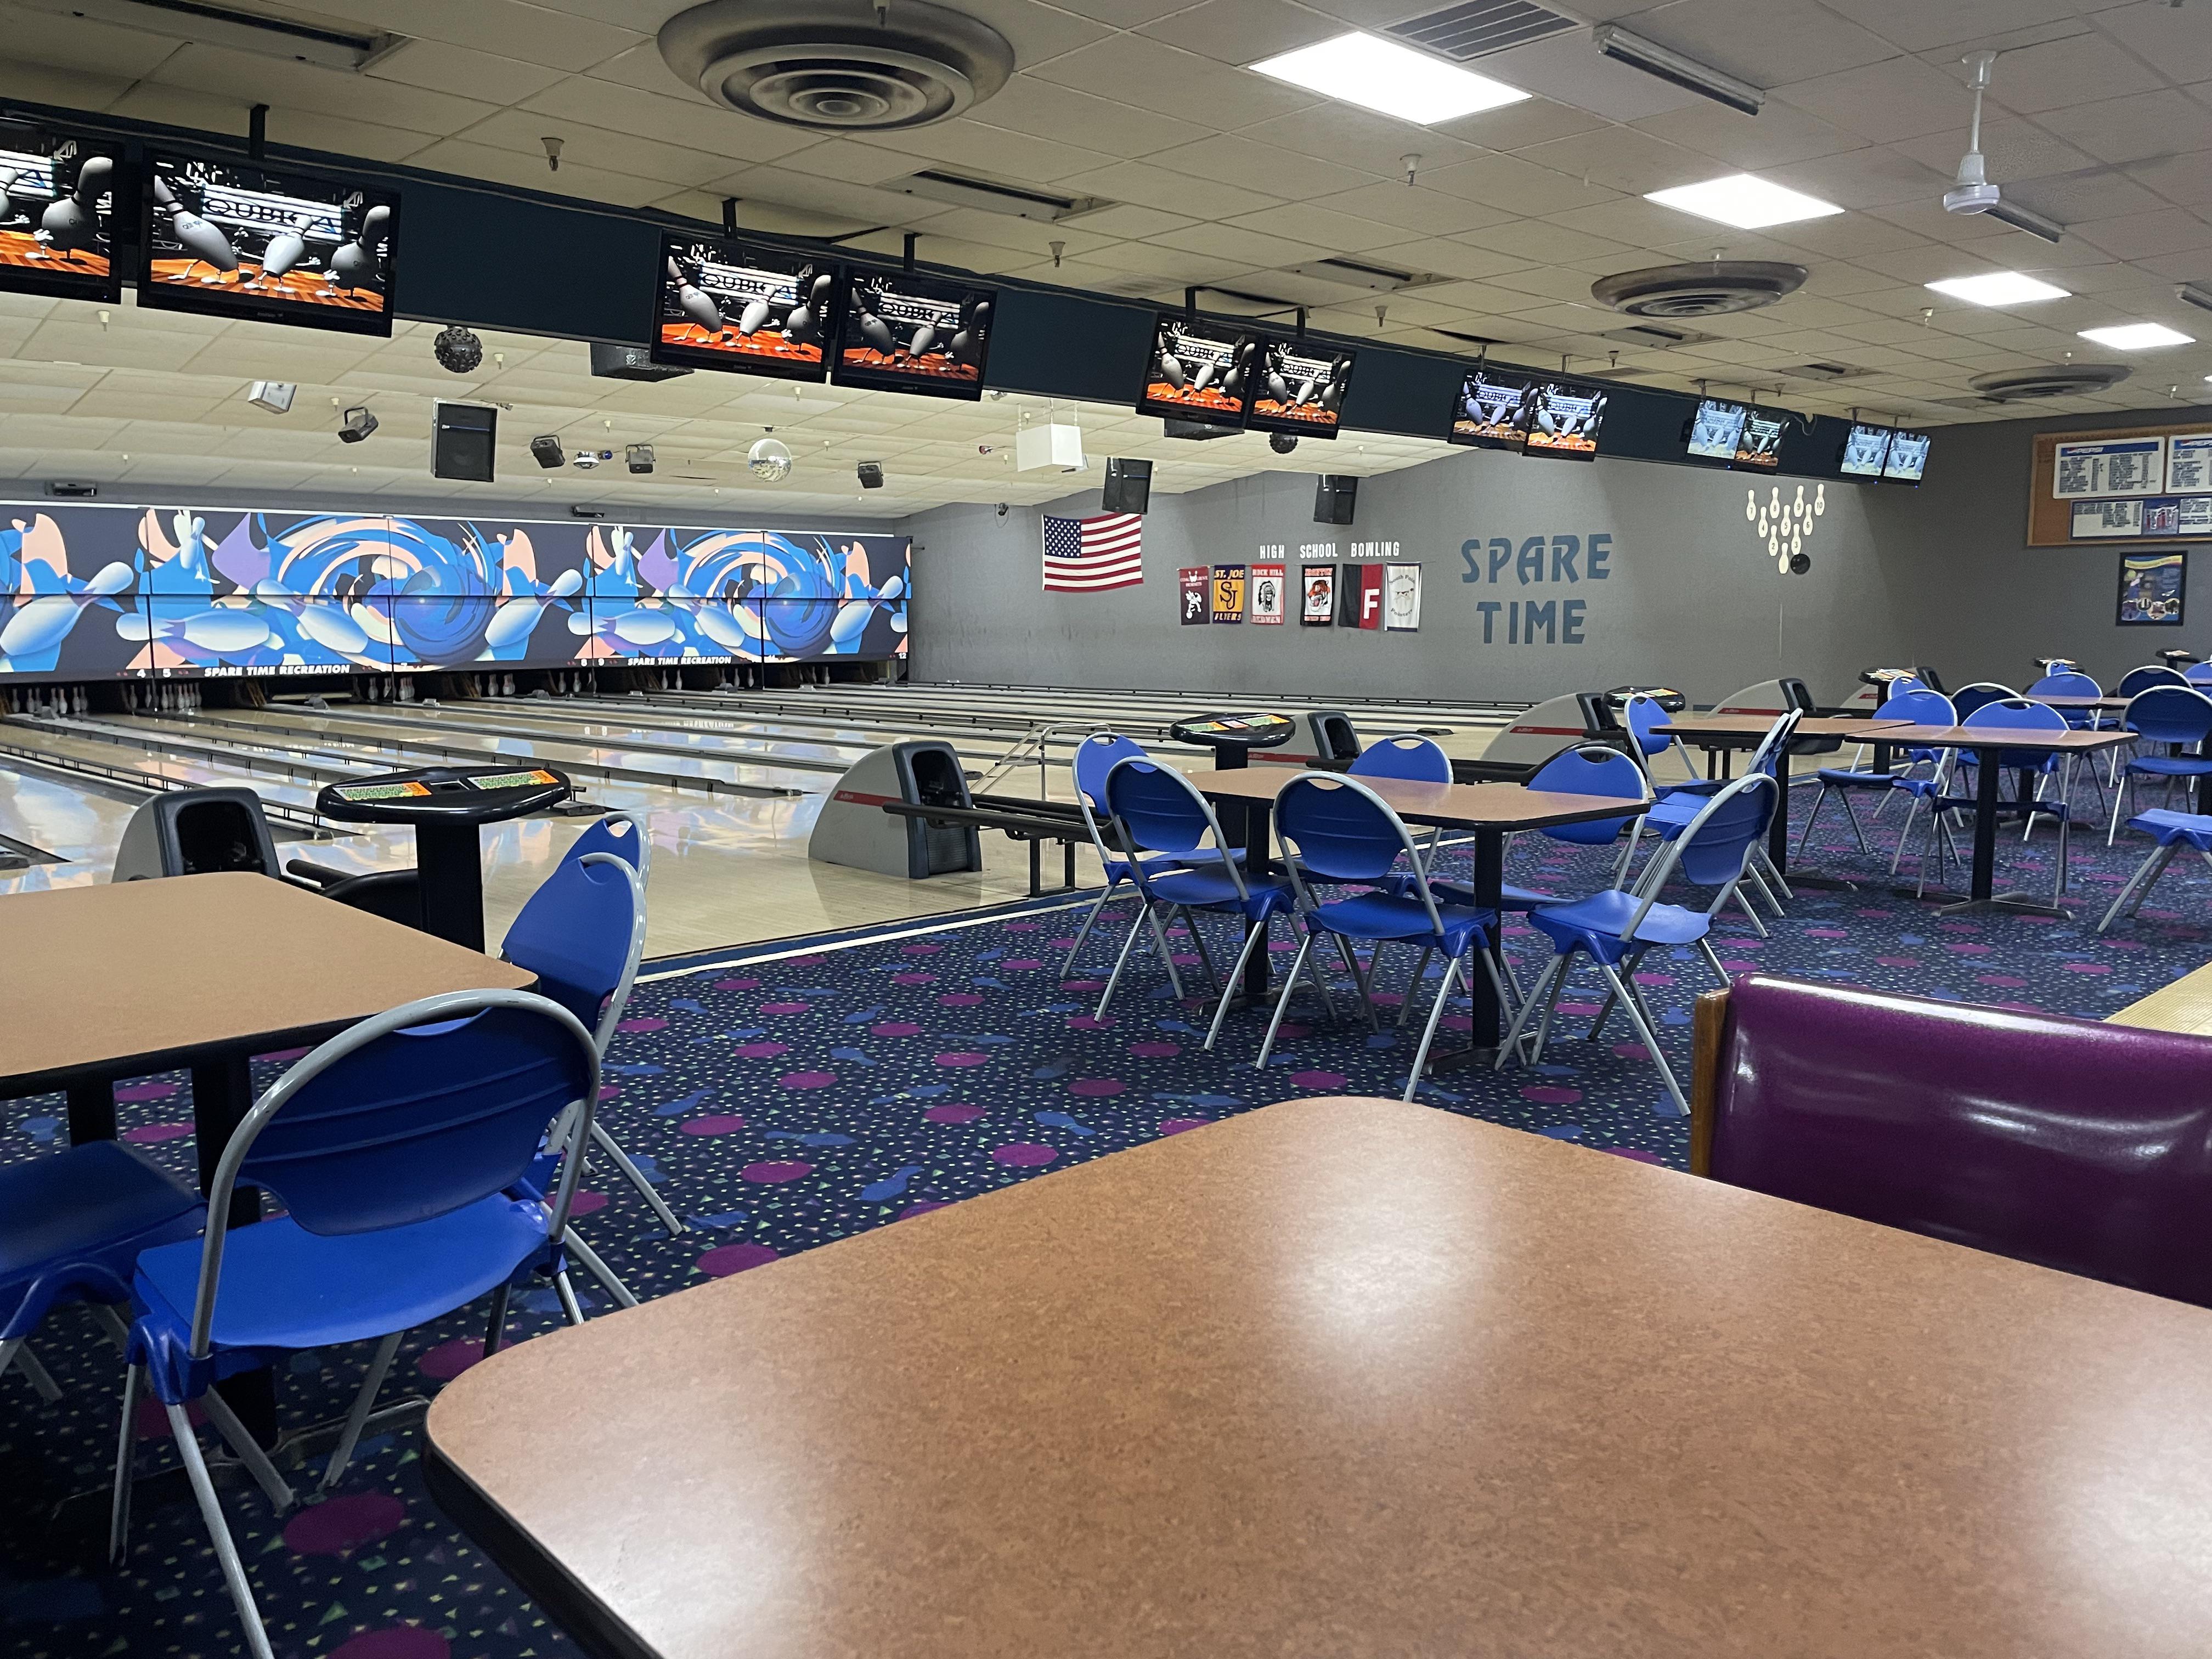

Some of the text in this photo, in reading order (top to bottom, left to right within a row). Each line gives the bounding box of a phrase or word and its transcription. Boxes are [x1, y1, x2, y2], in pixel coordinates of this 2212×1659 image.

[1260, 541, 1400, 559] HIGH SCHOOL BOWLING
[1461, 534, 1612, 585] SPARE
[1214, 570, 1226, 578] ST.
[1227, 569, 1244, 579] JOE
[1363, 589, 1379, 619] F
[1476, 600, 1587, 644] TIME
[581, 658, 588, 667] 8
[628, 656, 731, 666] SPARE TIME RECREATION
[137, 669, 146, 678] 4
[163, 669, 171, 678] 5
[204, 664, 350, 676] SPARE TIME RECREATION
